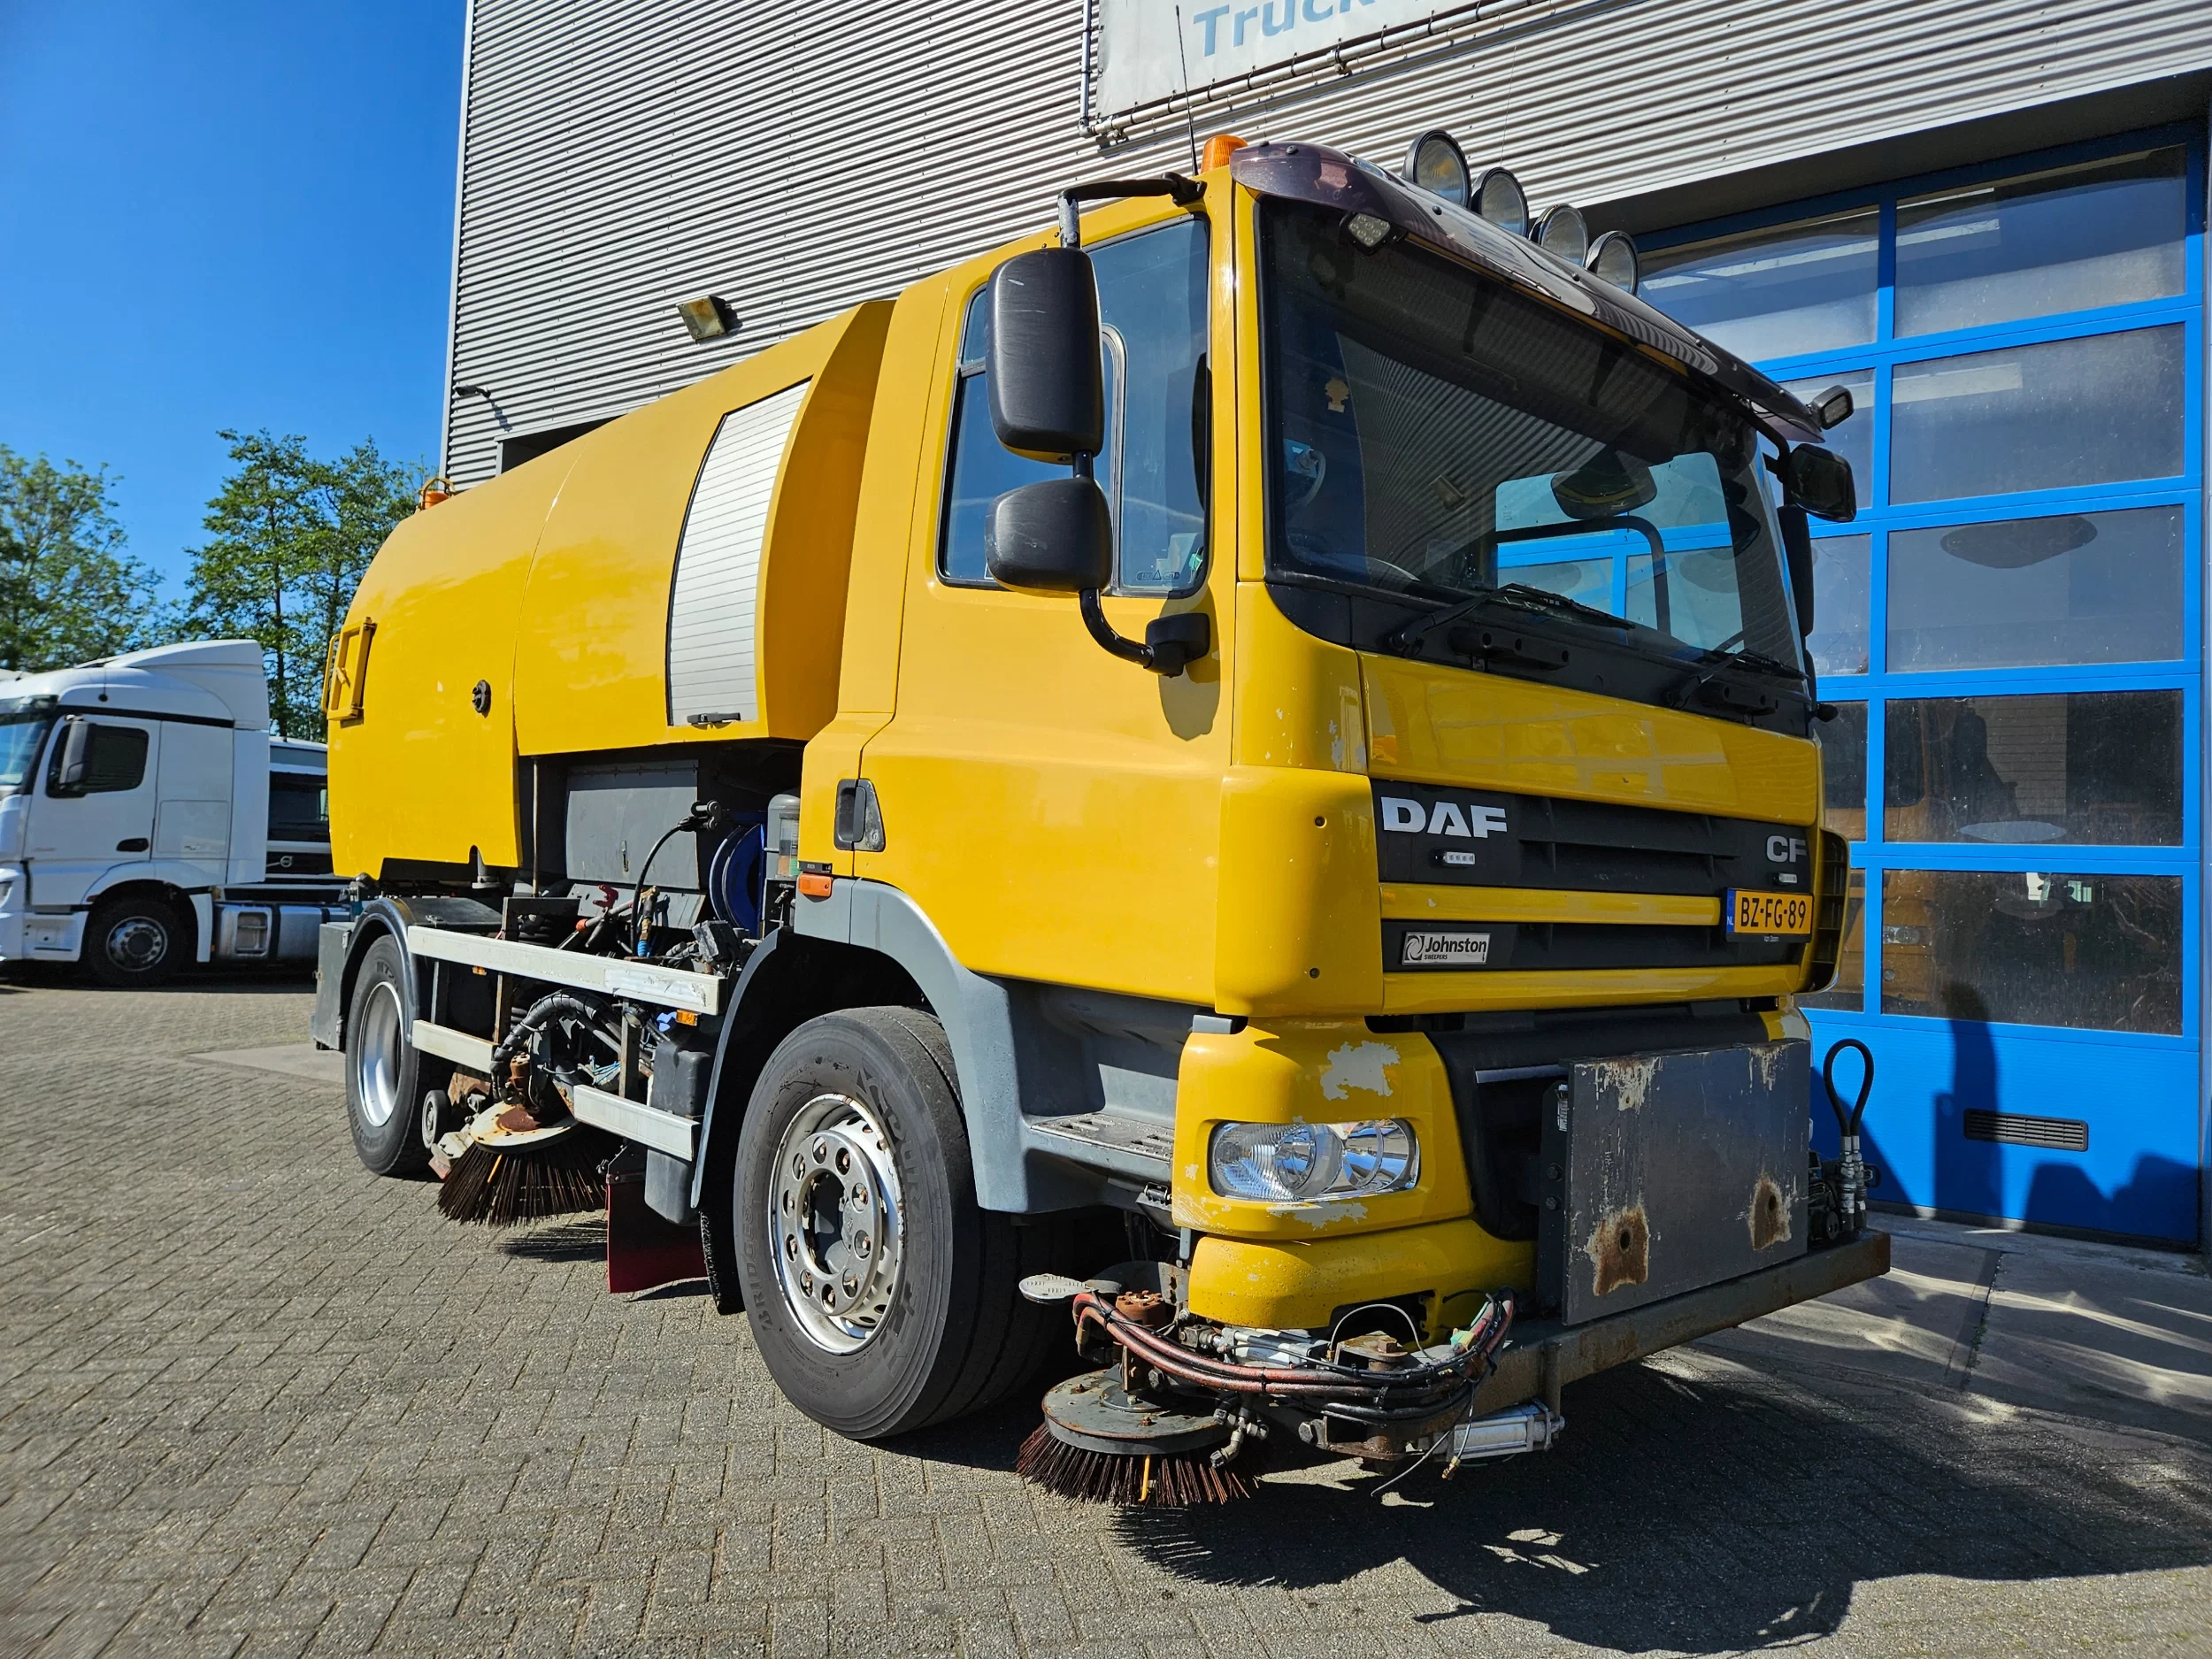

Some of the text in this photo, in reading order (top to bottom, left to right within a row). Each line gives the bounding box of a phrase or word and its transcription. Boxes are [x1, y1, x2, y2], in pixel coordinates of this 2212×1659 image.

[1193, 0, 1375, 57] Truc
[1380, 796, 1508, 839] DAF
[1766, 835, 1807, 863] CF
[1726, 916, 1734, 926] NL
[1740, 896, 1806, 929] BZ-FG-89
[1425, 935, 1486, 953] Johnston
